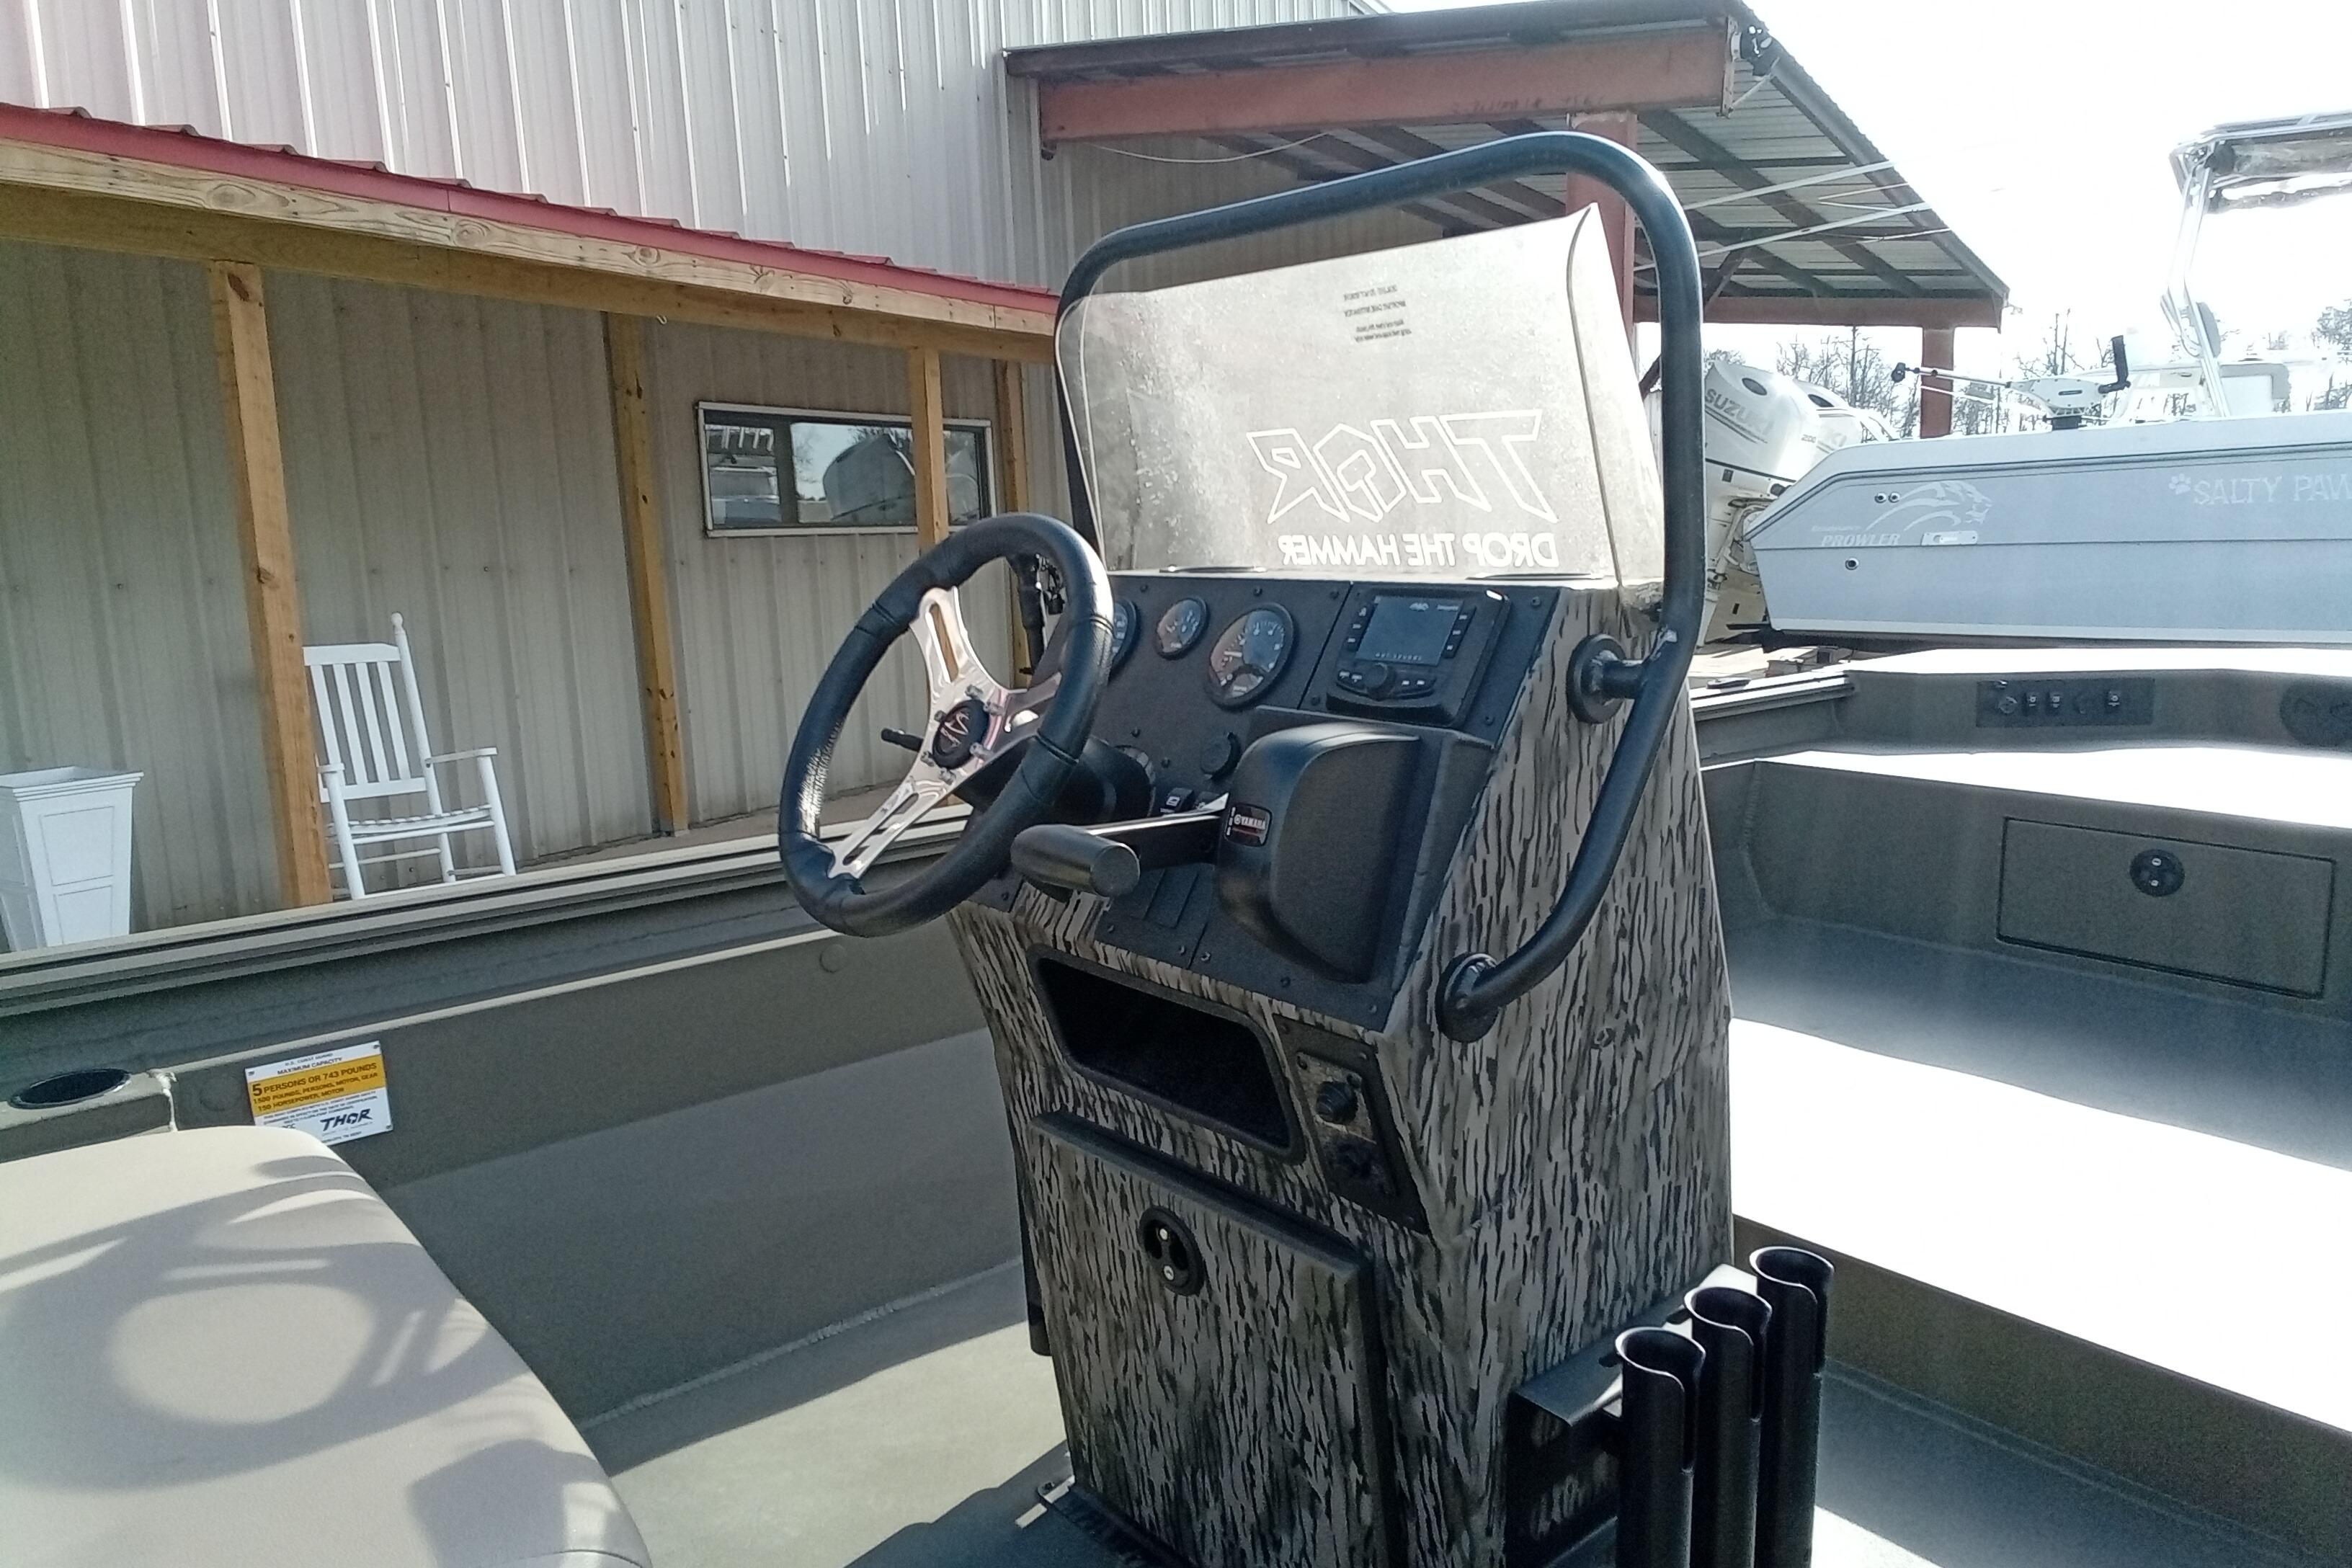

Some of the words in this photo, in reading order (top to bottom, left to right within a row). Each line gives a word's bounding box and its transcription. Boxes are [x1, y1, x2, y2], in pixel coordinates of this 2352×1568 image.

[1705, 388, 1775, 437] SUZUKI
[2192, 474, 2283, 506] SALTY
[1821, 533, 1901, 547] PROWLER
[277, 1064, 311, 1074] MAXIMUM
[311, 1057, 342, 1067] CAPACITY
[252, 1083, 262, 1097] 5
[264, 1078, 307, 1094] PERSONS
[323, 1071, 339, 1079] 743
[341, 1063, 377, 1076] POUNDS
[321, 1087, 344, 1096] MOTOR
[320, 1108, 373, 1132] THOR
